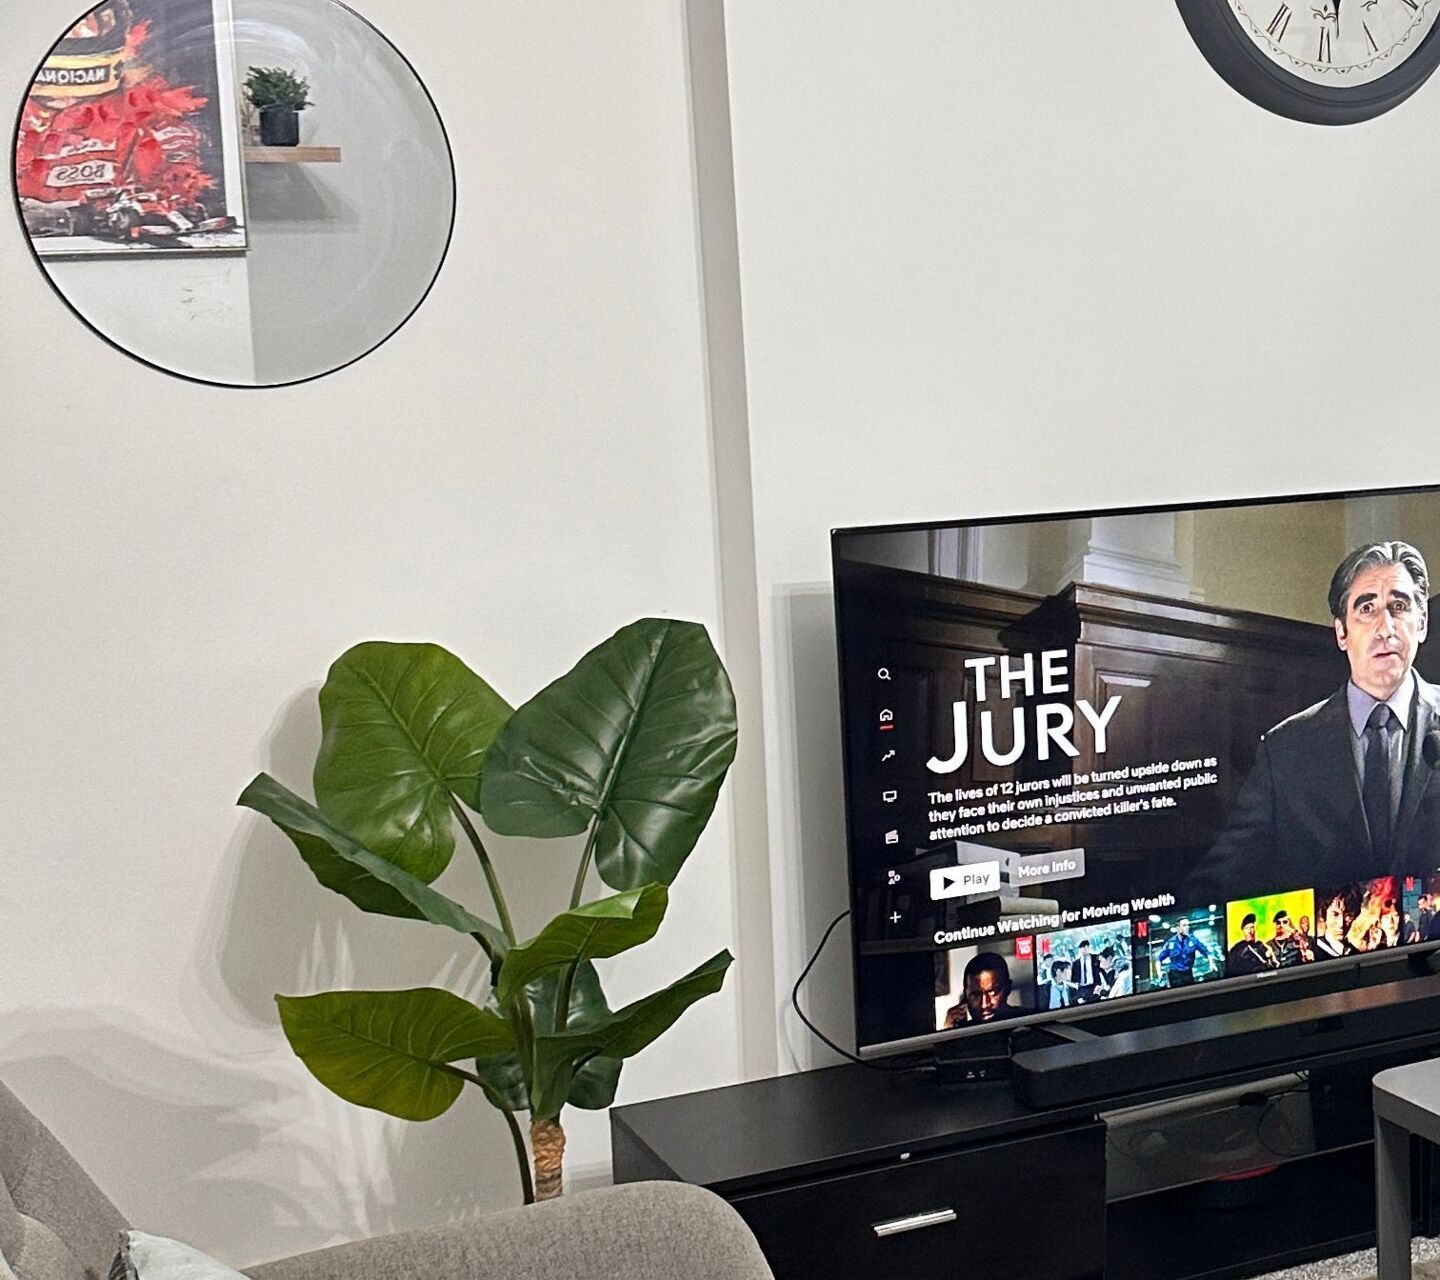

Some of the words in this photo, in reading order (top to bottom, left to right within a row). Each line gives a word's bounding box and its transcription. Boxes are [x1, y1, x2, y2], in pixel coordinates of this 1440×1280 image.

[964, 649, 1069, 702] THE
[926, 695, 1123, 774] JURY
[927, 791, 953, 805] The
[955, 788, 983, 801] lives
[986, 784, 998, 797] of
[1000, 782, 1014, 795] 12
[1015, 779, 1050, 796] jurors
[1052, 774, 1072, 786] will
[1074, 773, 1090, 785] be
[1091, 766, 1129, 782] turned
[1131, 762, 1170, 779] upside
[1171, 759, 1202, 772] down
[1204, 757, 1218, 768] as
[928, 810, 957, 823] they
[958, 805, 986, 819] face
[987, 800, 1015, 814] their
[1017, 797, 1043, 810] own
[1045, 790, 1101, 808] injustices
[1101, 784, 1124, 799] and
[1126, 777, 1181, 795] unwanted
[1183, 772, 1218, 790] public
[929, 823, 985, 840] attention
[986, 820, 1000, 832] to
[1002, 815, 1043, 830] decide
[1045, 814, 1052, 824] a
[1054, 803, 1112, 823] convicted
[1113, 799, 1150, 814] killer's
[1151, 796, 1177, 809] fate.
[963, 872, 990, 886] Play
[1018, 863, 1049, 878] More
[1052, 858, 1077, 873] Info
[933, 925, 996, 945] Continue
[997, 912, 1061, 934] Watching
[1062, 908, 1081, 924] for
[1082, 900, 1130, 920] Moving
[1131, 893, 1176, 912] Wealth
